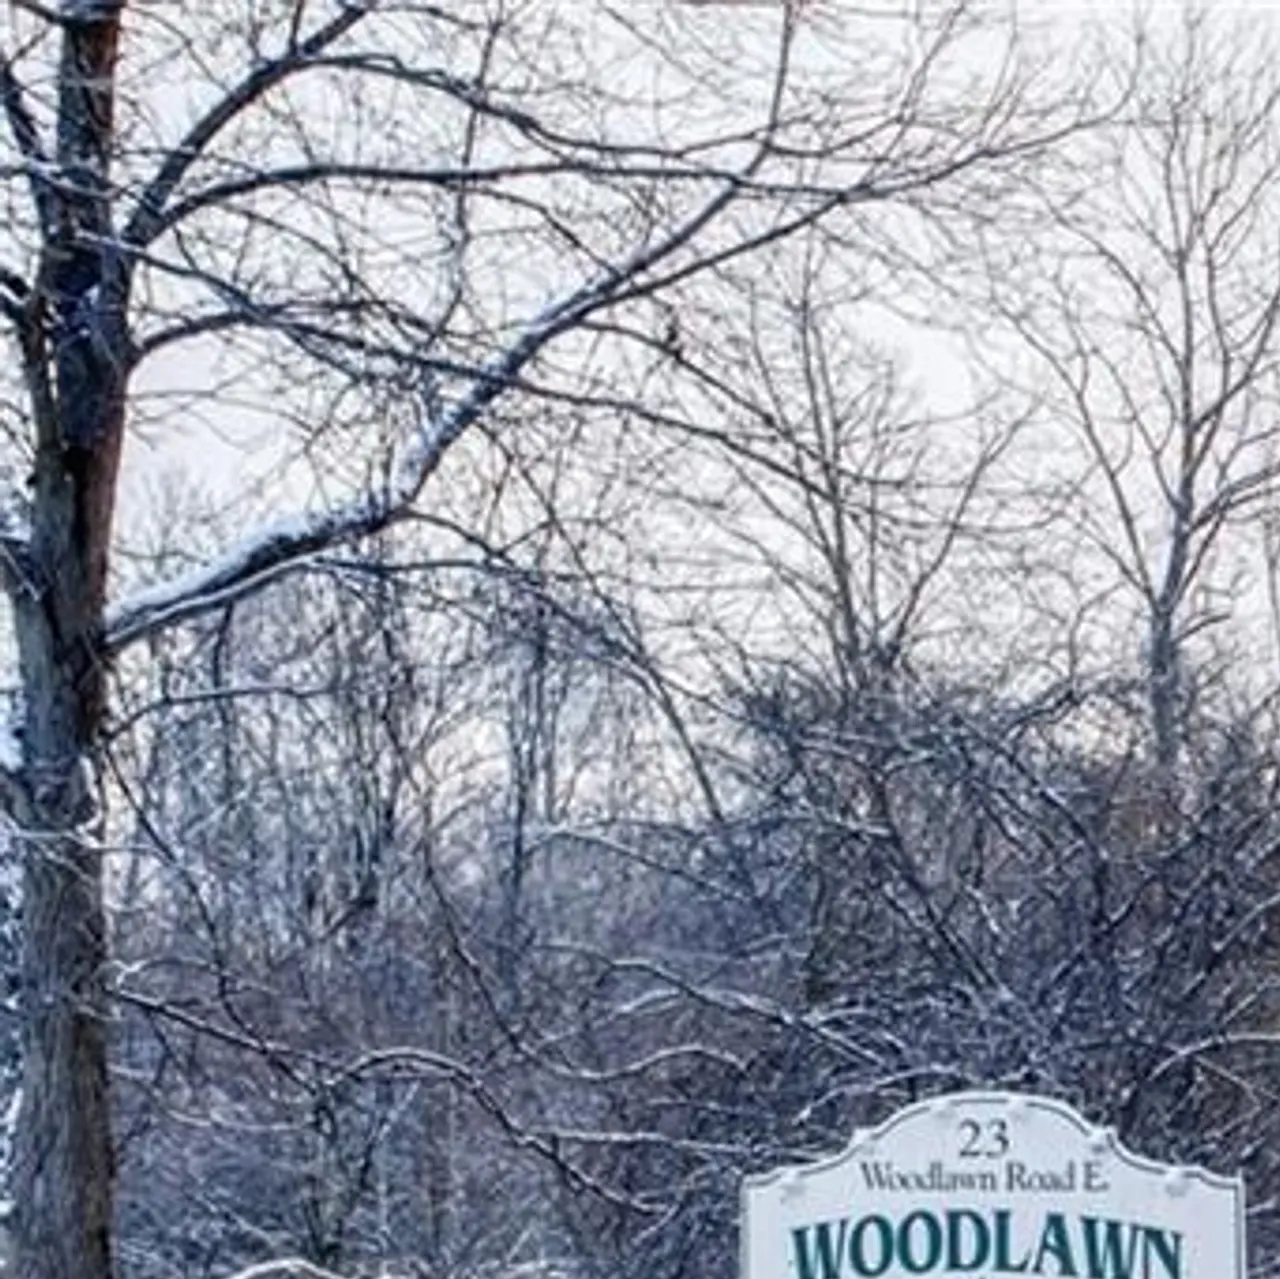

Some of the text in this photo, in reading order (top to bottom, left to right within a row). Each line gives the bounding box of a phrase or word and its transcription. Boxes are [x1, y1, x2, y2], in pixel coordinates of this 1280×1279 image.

[958, 1117, 1010, 1159] 23
[860, 1160, 1109, 1192] Woodlawn Road E.
